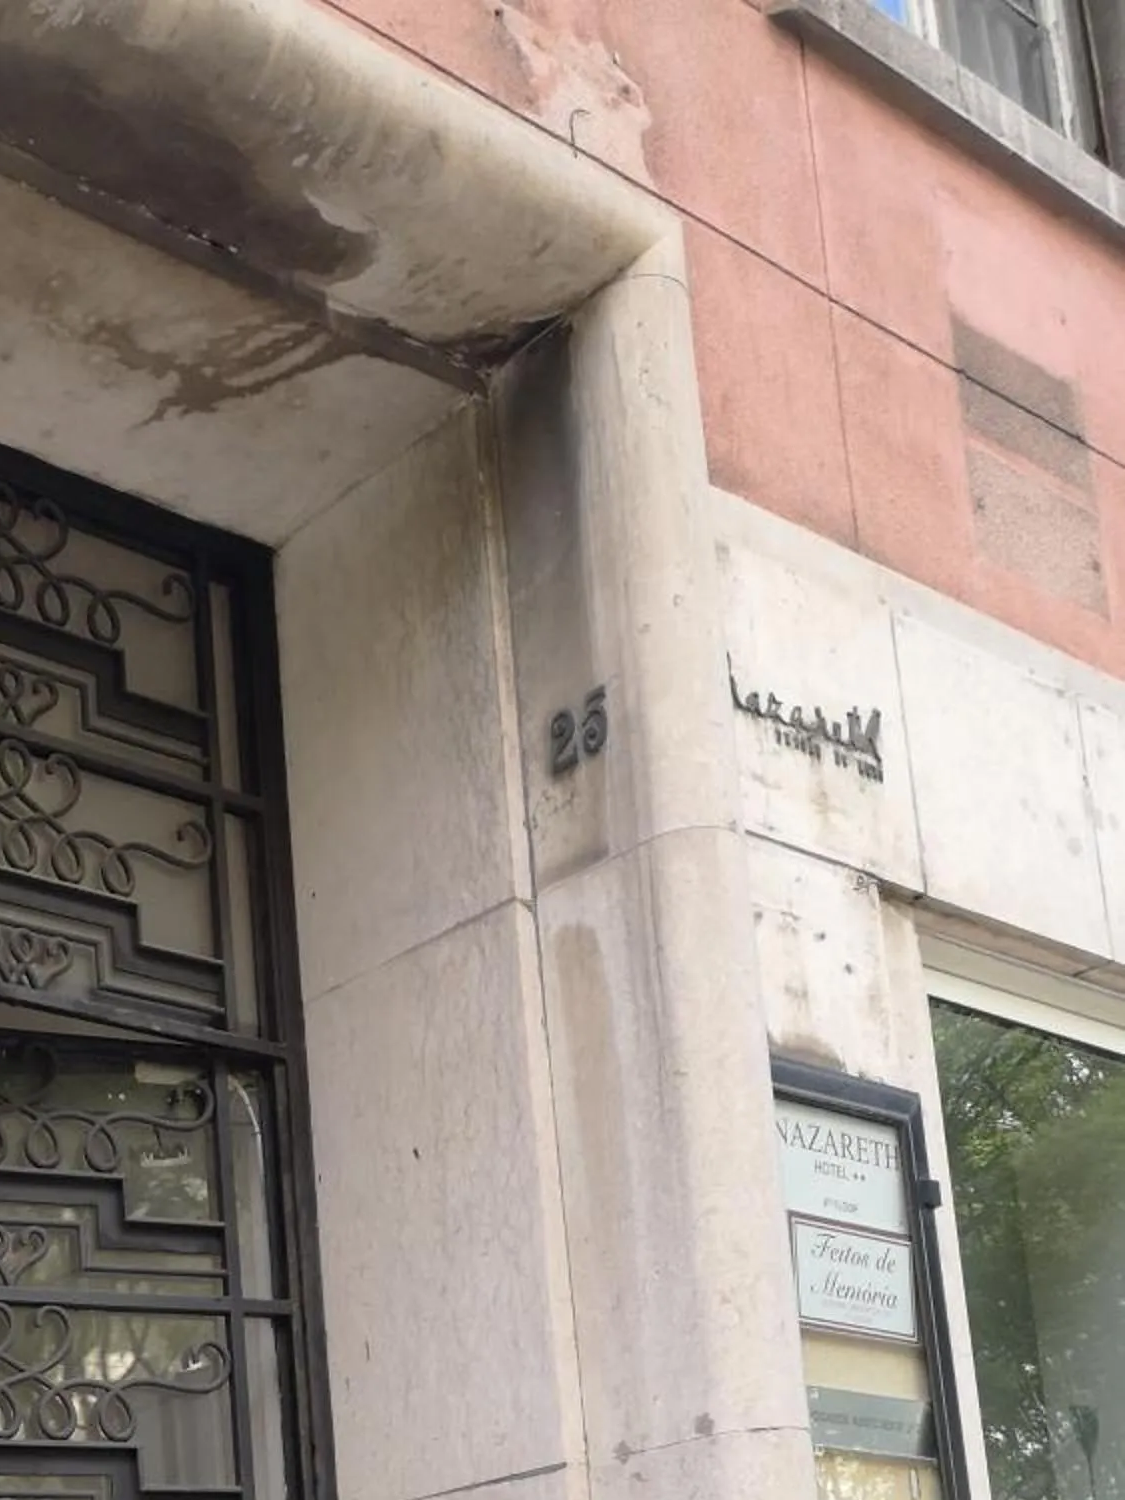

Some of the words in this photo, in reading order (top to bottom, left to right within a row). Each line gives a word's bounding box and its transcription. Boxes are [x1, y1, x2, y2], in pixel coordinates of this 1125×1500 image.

[775, 1118, 901, 1171] NAZARETH
[814, 1159, 850, 1182] HOTEL
[810, 1232, 870, 1268] Feitos
[875, 1247, 896, 1273] de
